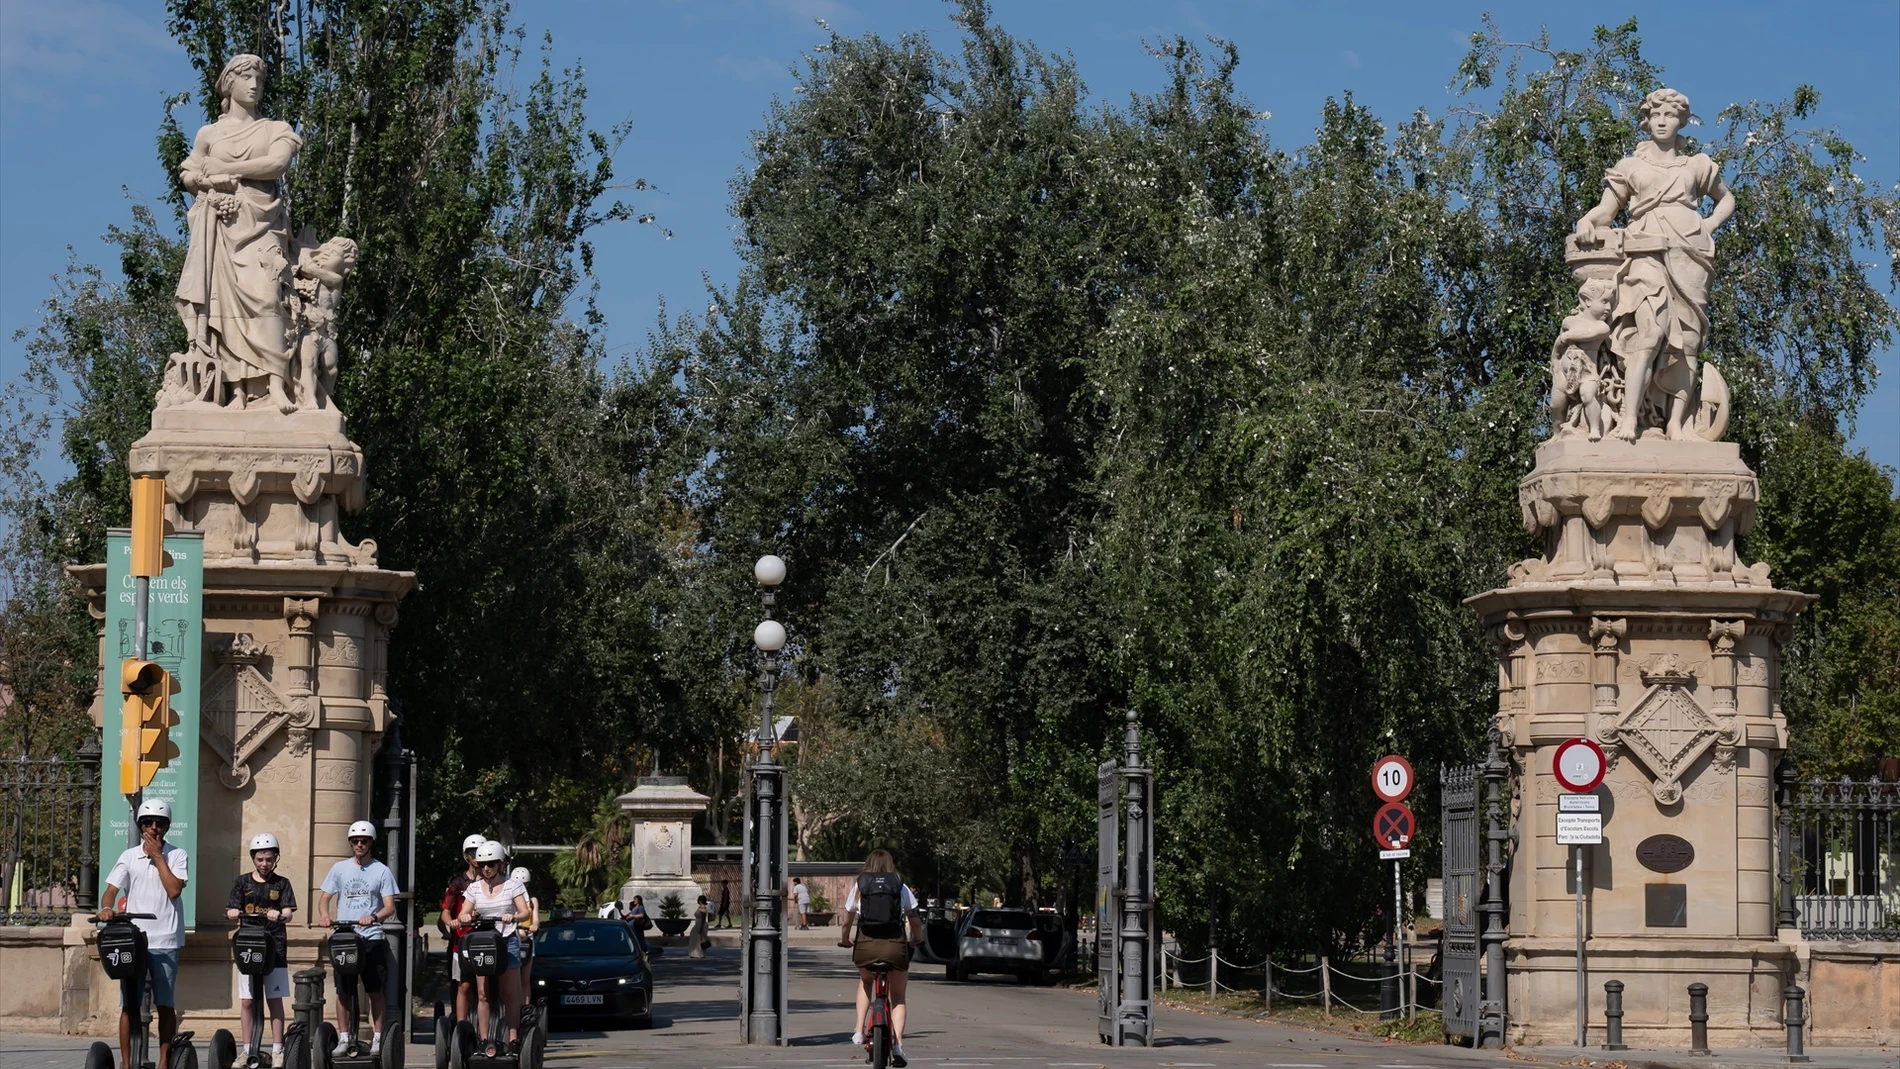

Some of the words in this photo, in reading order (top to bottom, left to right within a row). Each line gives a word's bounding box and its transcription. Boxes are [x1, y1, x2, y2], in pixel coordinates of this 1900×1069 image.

[123, 574, 168, 589] Cuem
[171, 576, 186, 589] els
[120, 592, 154, 606] esps
[158, 590, 188, 603] verds
[1383, 770, 1400, 786] 10
[566, 996, 585, 1004] 4469
[587, 996, 602, 1004] LVN
